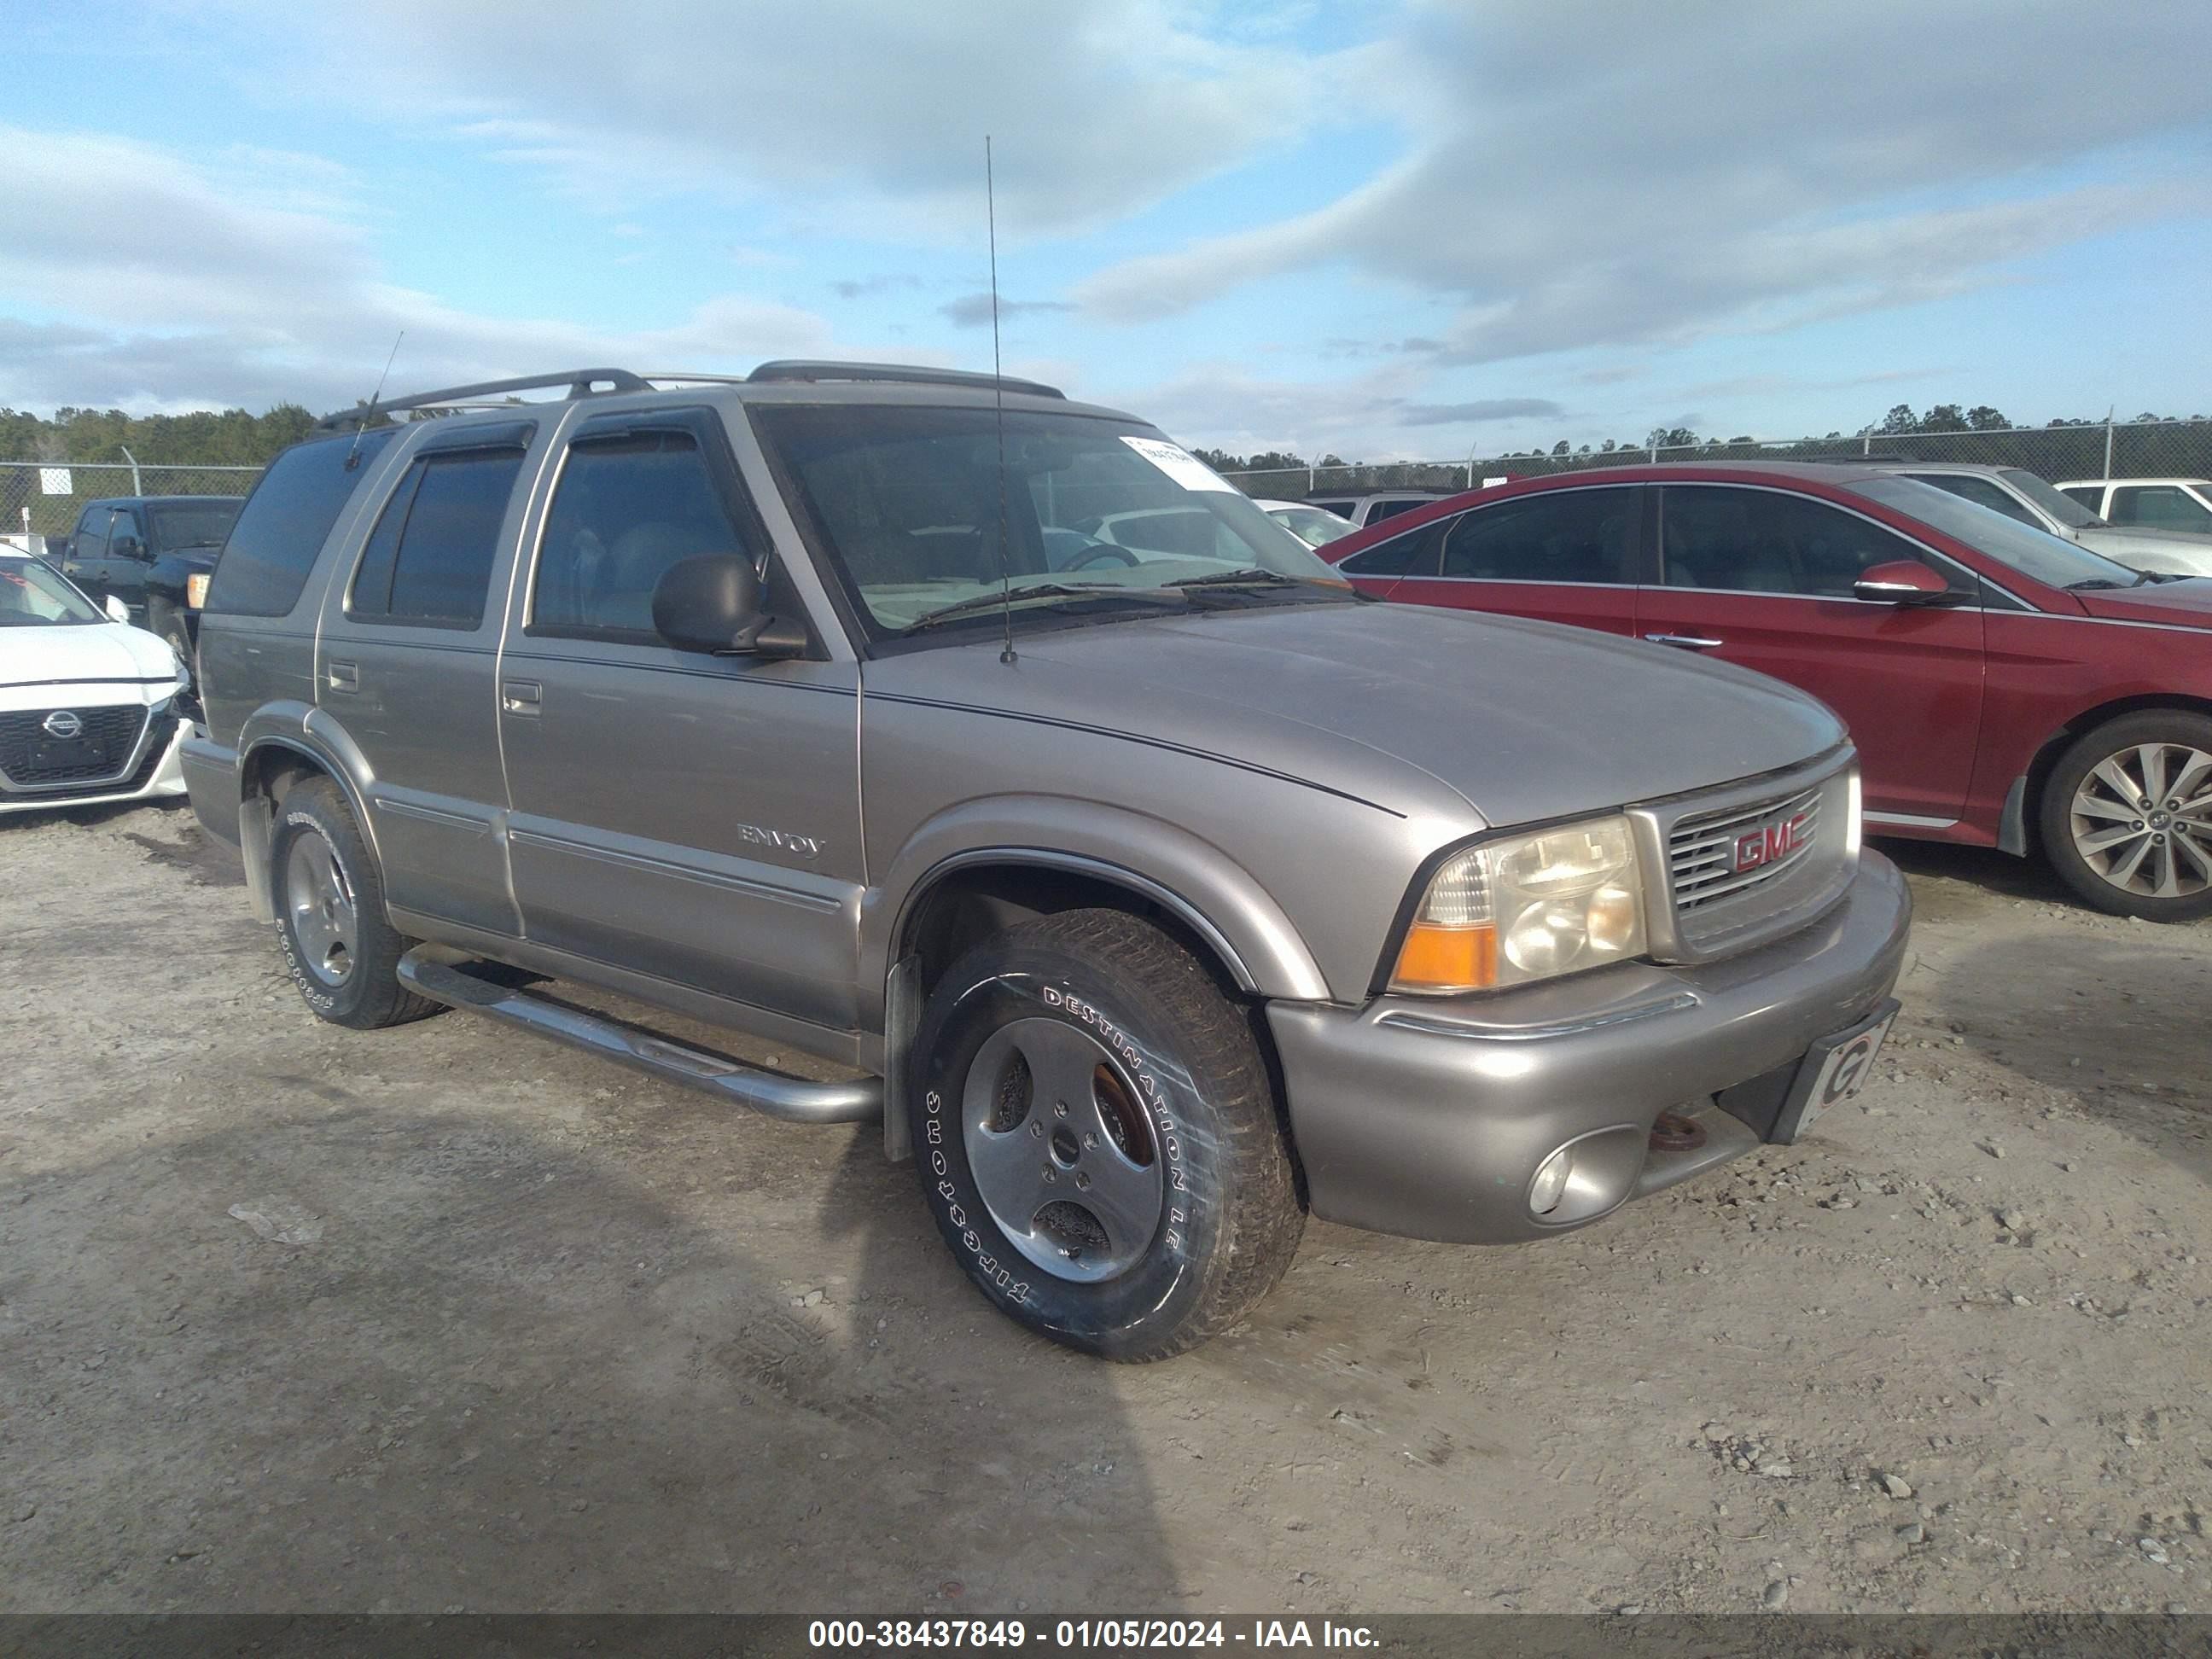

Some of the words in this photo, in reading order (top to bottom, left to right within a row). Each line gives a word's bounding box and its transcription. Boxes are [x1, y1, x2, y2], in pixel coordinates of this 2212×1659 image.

[736, 823, 826, 860] ENVOY
[1734, 812, 1808, 874] GMC
[1822, 1039, 1869, 1105] G
[1043, 986, 1185, 1191] DESTINATION
[1166, 1207, 1185, 1250] LE
[927, 1091, 1029, 1304] Firestone
